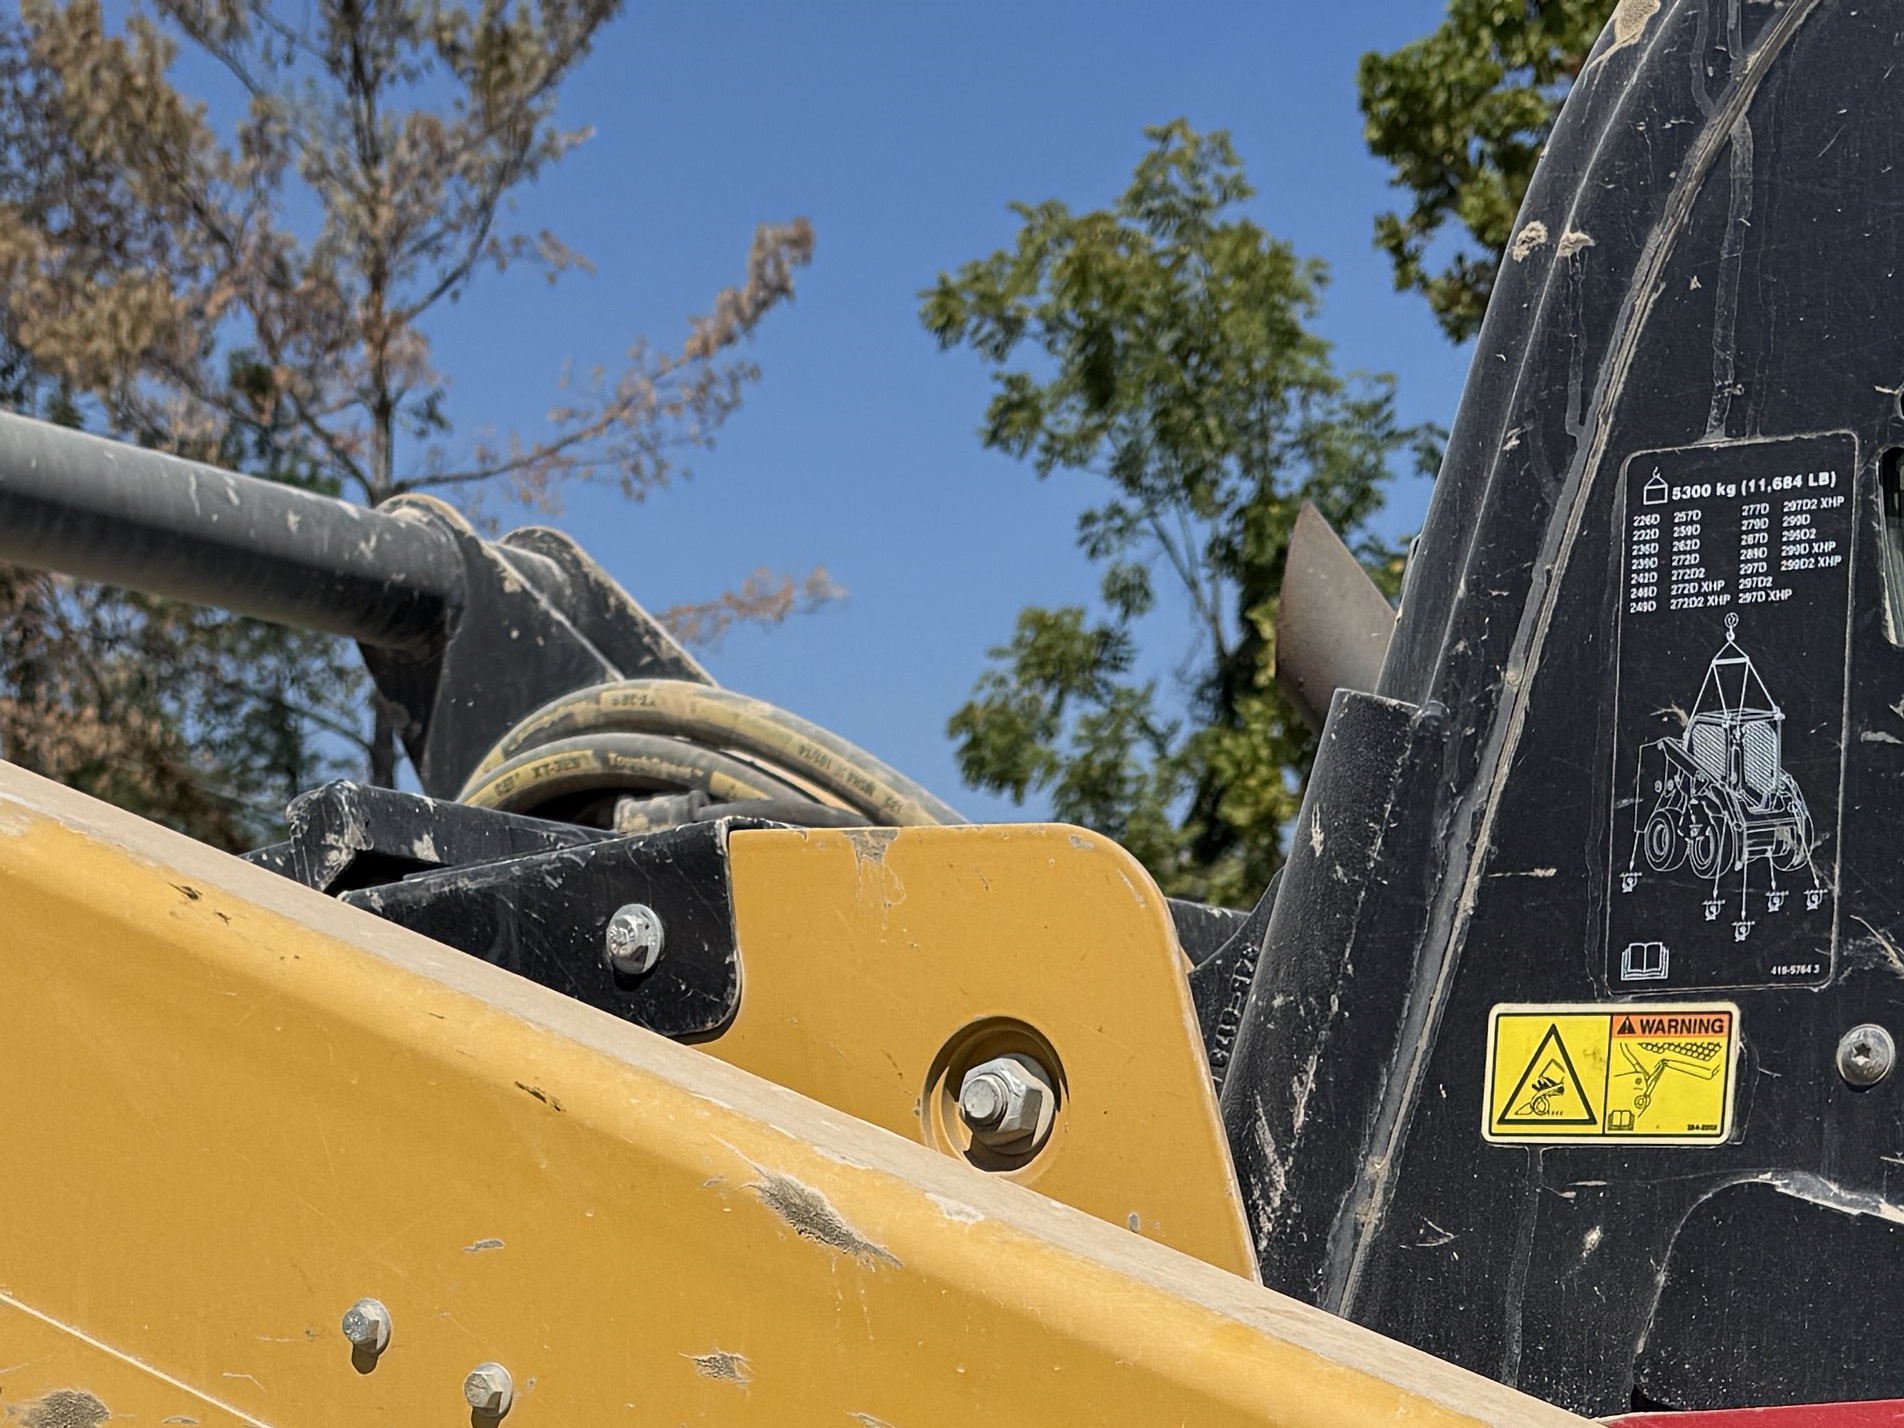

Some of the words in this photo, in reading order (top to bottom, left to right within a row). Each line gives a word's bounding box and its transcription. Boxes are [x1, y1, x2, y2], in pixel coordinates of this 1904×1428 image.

[1672, 484, 1711, 500] 5300
[1717, 482, 1736, 498] kg
[1741, 475, 1802, 496] (11,684
[1808, 471, 1836, 488] LB)
[1820, 495, 1845, 509] XHP
[1812, 541, 1837, 554] XHP
[1818, 555, 1842, 568] XHP
[1701, 580, 1725, 593] XHP
[1707, 594, 1731, 607] XHP
[1767, 588, 1793, 601] XHP
[1639, 1017, 1725, 1035] WARNING
